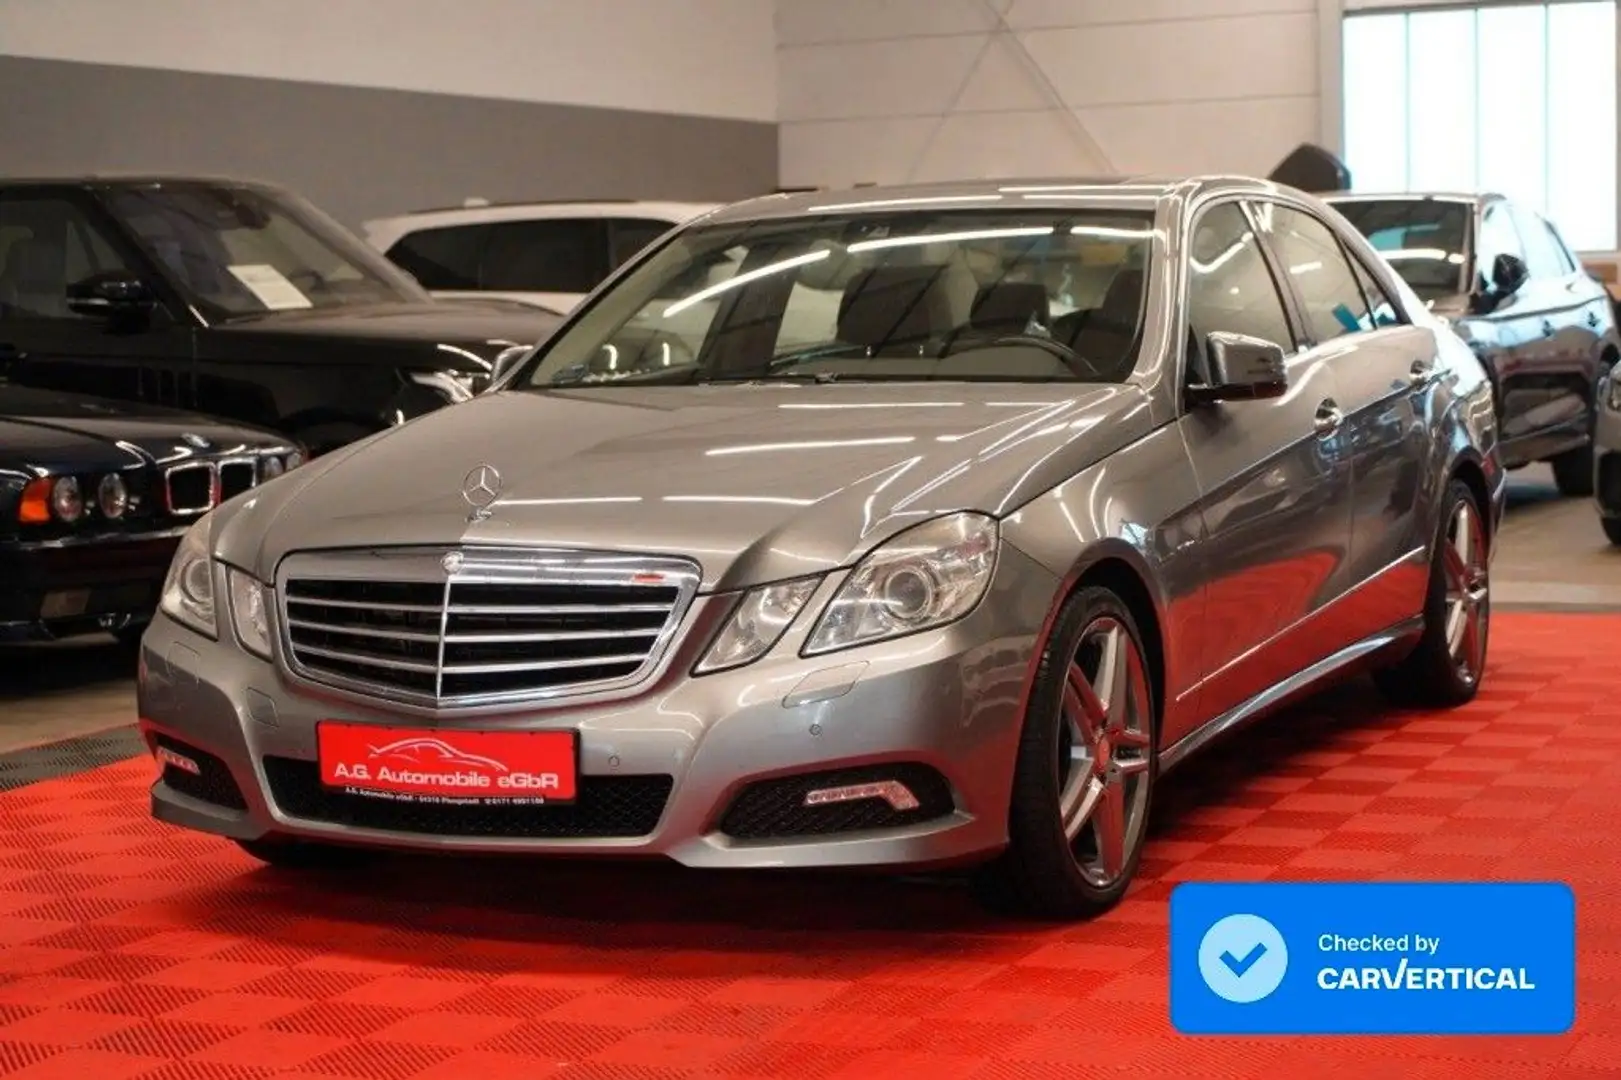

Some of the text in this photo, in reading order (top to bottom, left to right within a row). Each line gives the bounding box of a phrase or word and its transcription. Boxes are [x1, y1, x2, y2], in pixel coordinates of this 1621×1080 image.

[334, 762, 558, 789] A.G. Automobile eGbR
